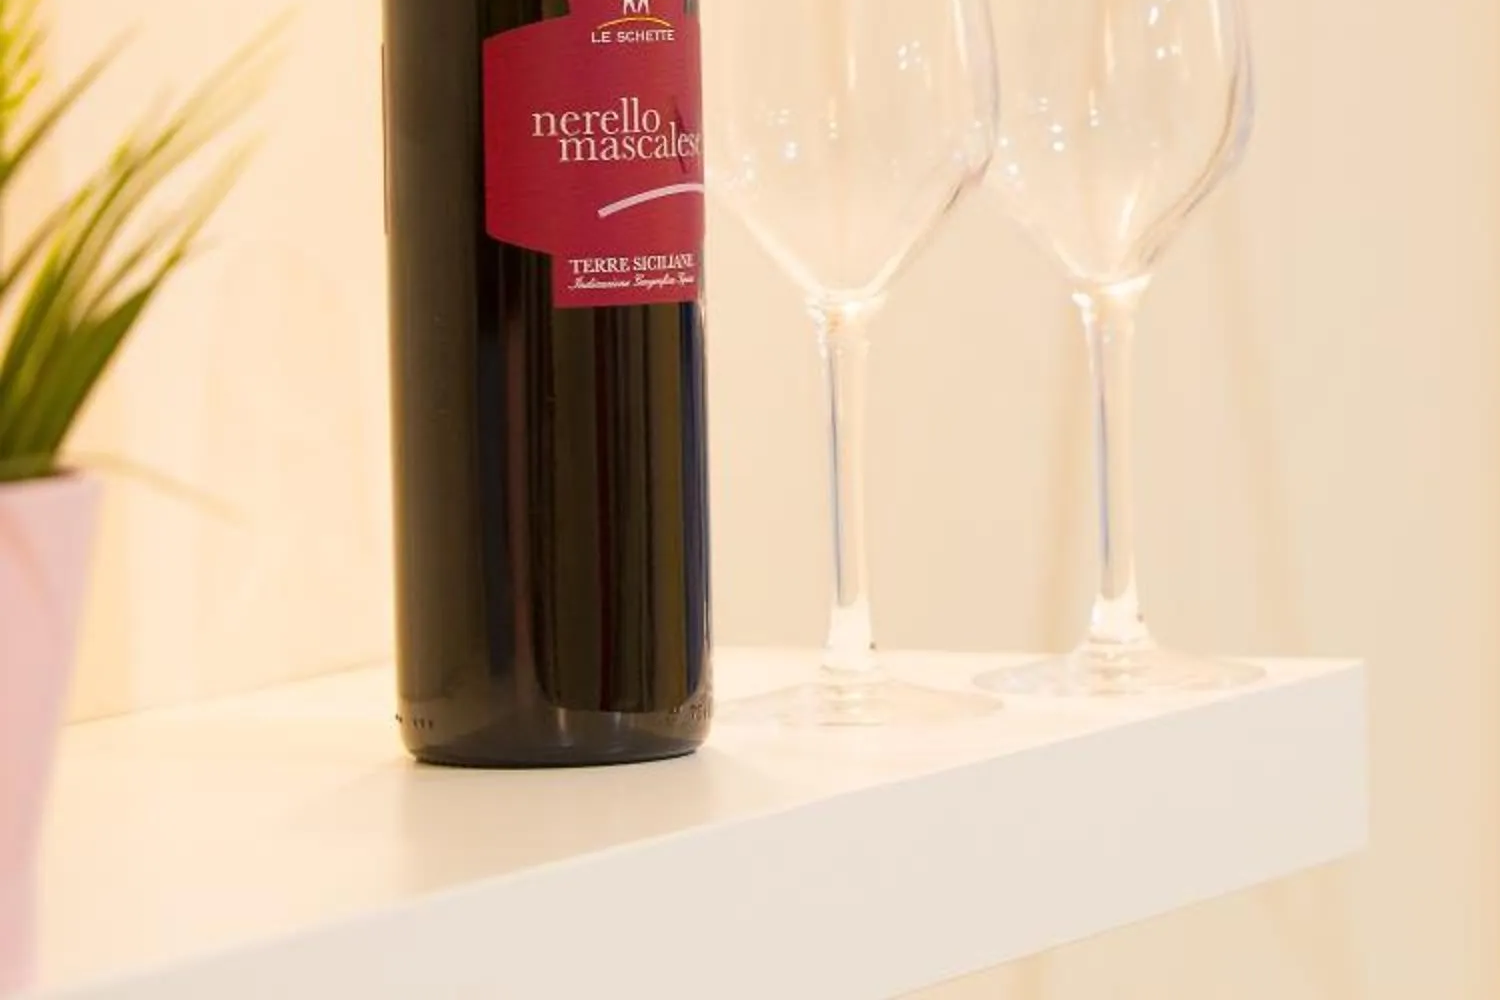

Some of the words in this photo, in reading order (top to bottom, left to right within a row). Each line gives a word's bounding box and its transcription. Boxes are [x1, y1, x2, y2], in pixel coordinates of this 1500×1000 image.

[591, 31, 611, 43] LE
[616, 29, 675, 42] SCHETTE
[531, 97, 660, 136] nerello
[568, 258, 631, 274] TERRE
[633, 253, 695, 271] SICILIANE
